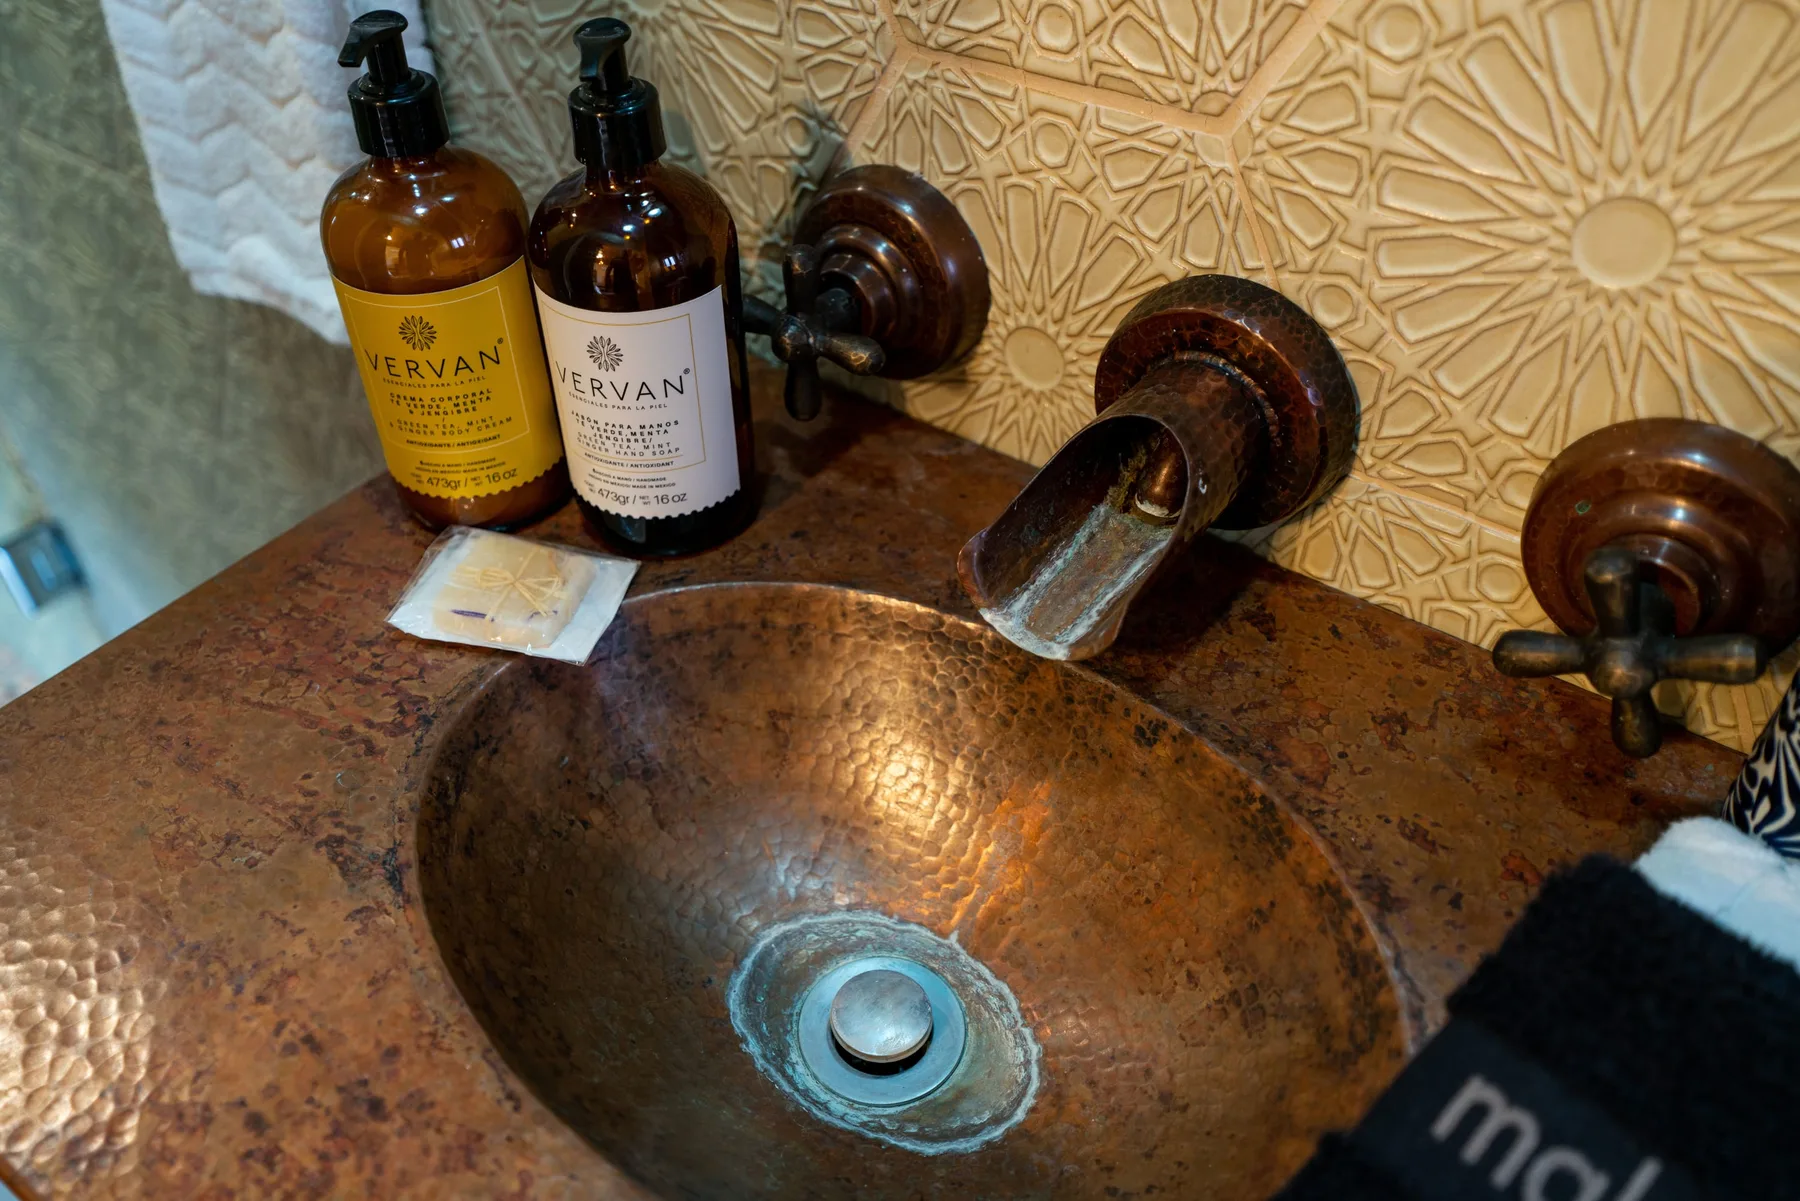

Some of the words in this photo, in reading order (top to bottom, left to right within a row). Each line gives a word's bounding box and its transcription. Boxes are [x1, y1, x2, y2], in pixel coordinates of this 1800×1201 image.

[383, 378, 427, 388] ESENCIALES
[468, 375, 486, 383] PIEL
[389, 392, 424, 402] CREMA
[430, 388, 492, 402] CORPORAL
[453, 396, 491, 408] MENTA
[569, 392, 608, 409] ESENCIALES
[420, 406, 477, 416] JENGIBRE
[397, 418, 428, 429] GREEN
[467, 416, 494, 426] MINT
[398, 426, 435, 436] GINGER
[441, 428, 470, 436] BODY
[477, 416, 512, 432] CREAM
[605, 422, 632, 430] PARA
[640, 420, 679, 430] MANOS
[456, 434, 501, 447] ANTIOXIDANT
[577, 438, 609, 453] GINGER
[652, 447, 680, 456] SOAP
[578, 432, 605, 446] GREEN
[643, 442, 671, 450] MINT
[584, 452, 624, 467] ANTIOXIDANTE
[427, 477, 462, 490] 473gr
[485, 472, 501, 484] 16
[503, 468, 518, 480] oz
[598, 488, 630, 505] 473gr
[654, 495, 669, 504] 16
[671, 493, 687, 503] oz
